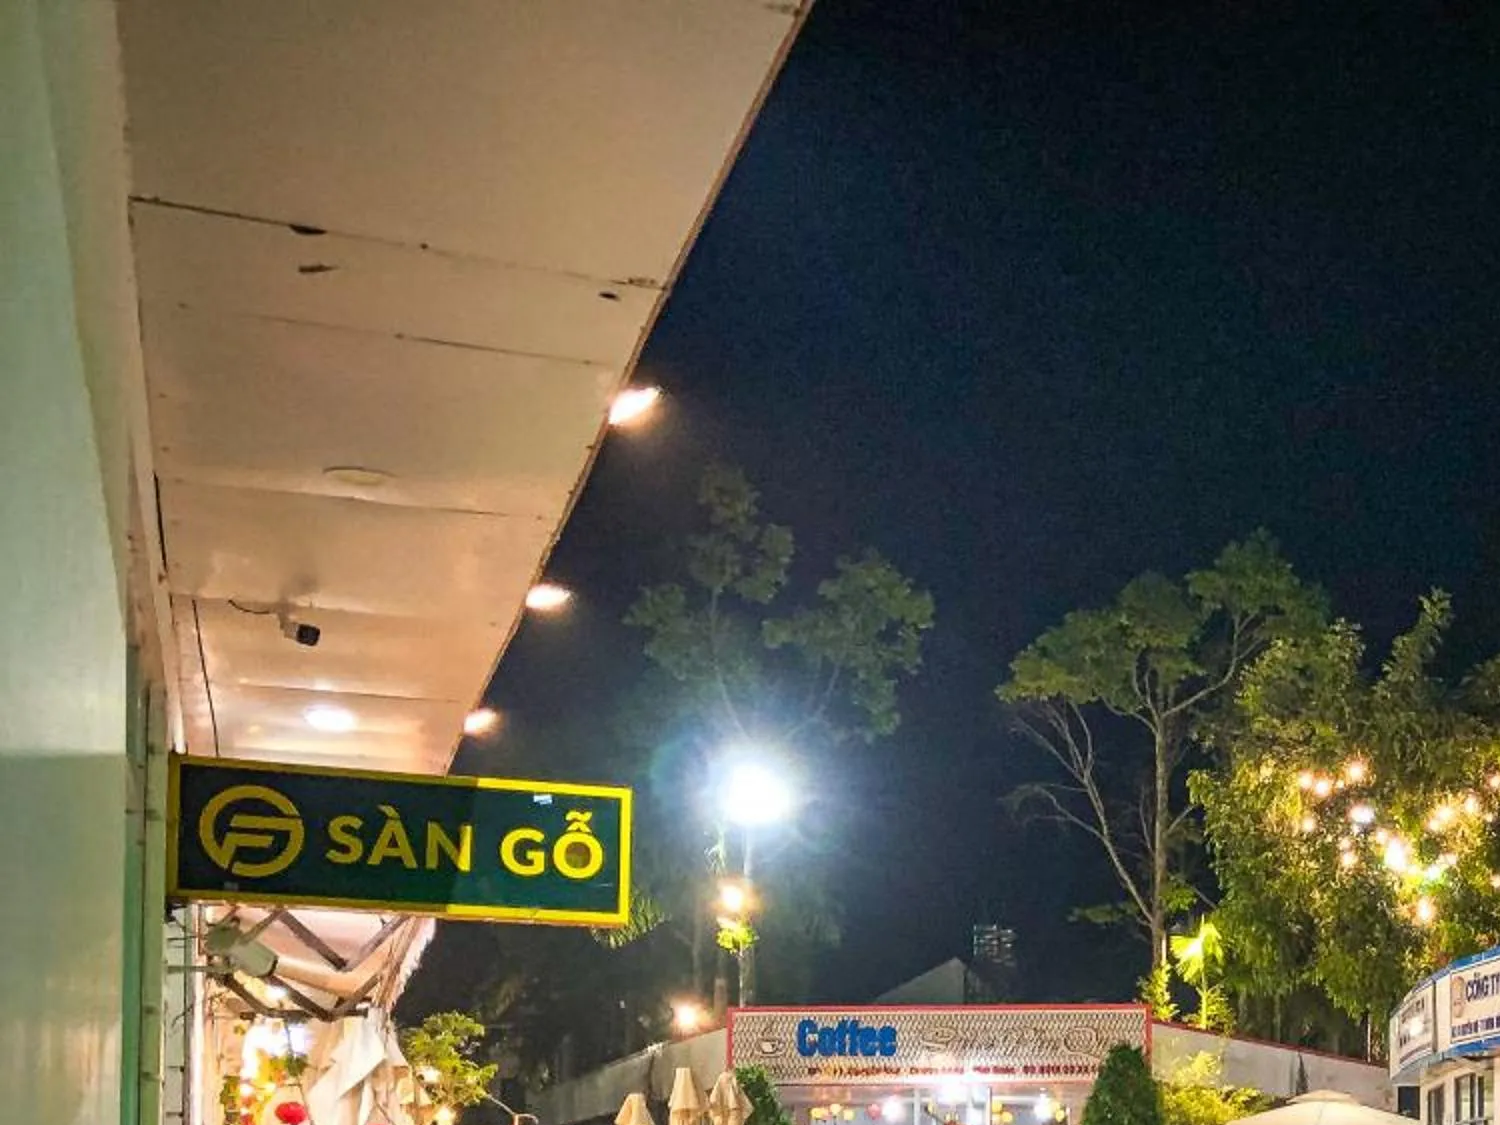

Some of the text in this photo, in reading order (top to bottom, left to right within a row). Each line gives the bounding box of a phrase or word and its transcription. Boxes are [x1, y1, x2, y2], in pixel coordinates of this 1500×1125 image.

[325, 804, 604, 880] SÀN GỖ
[1465, 971, 1489, 1002] CÔNG
[1491, 971, 1500, 995] TY
[796, 1017, 898, 1057] Coffee
